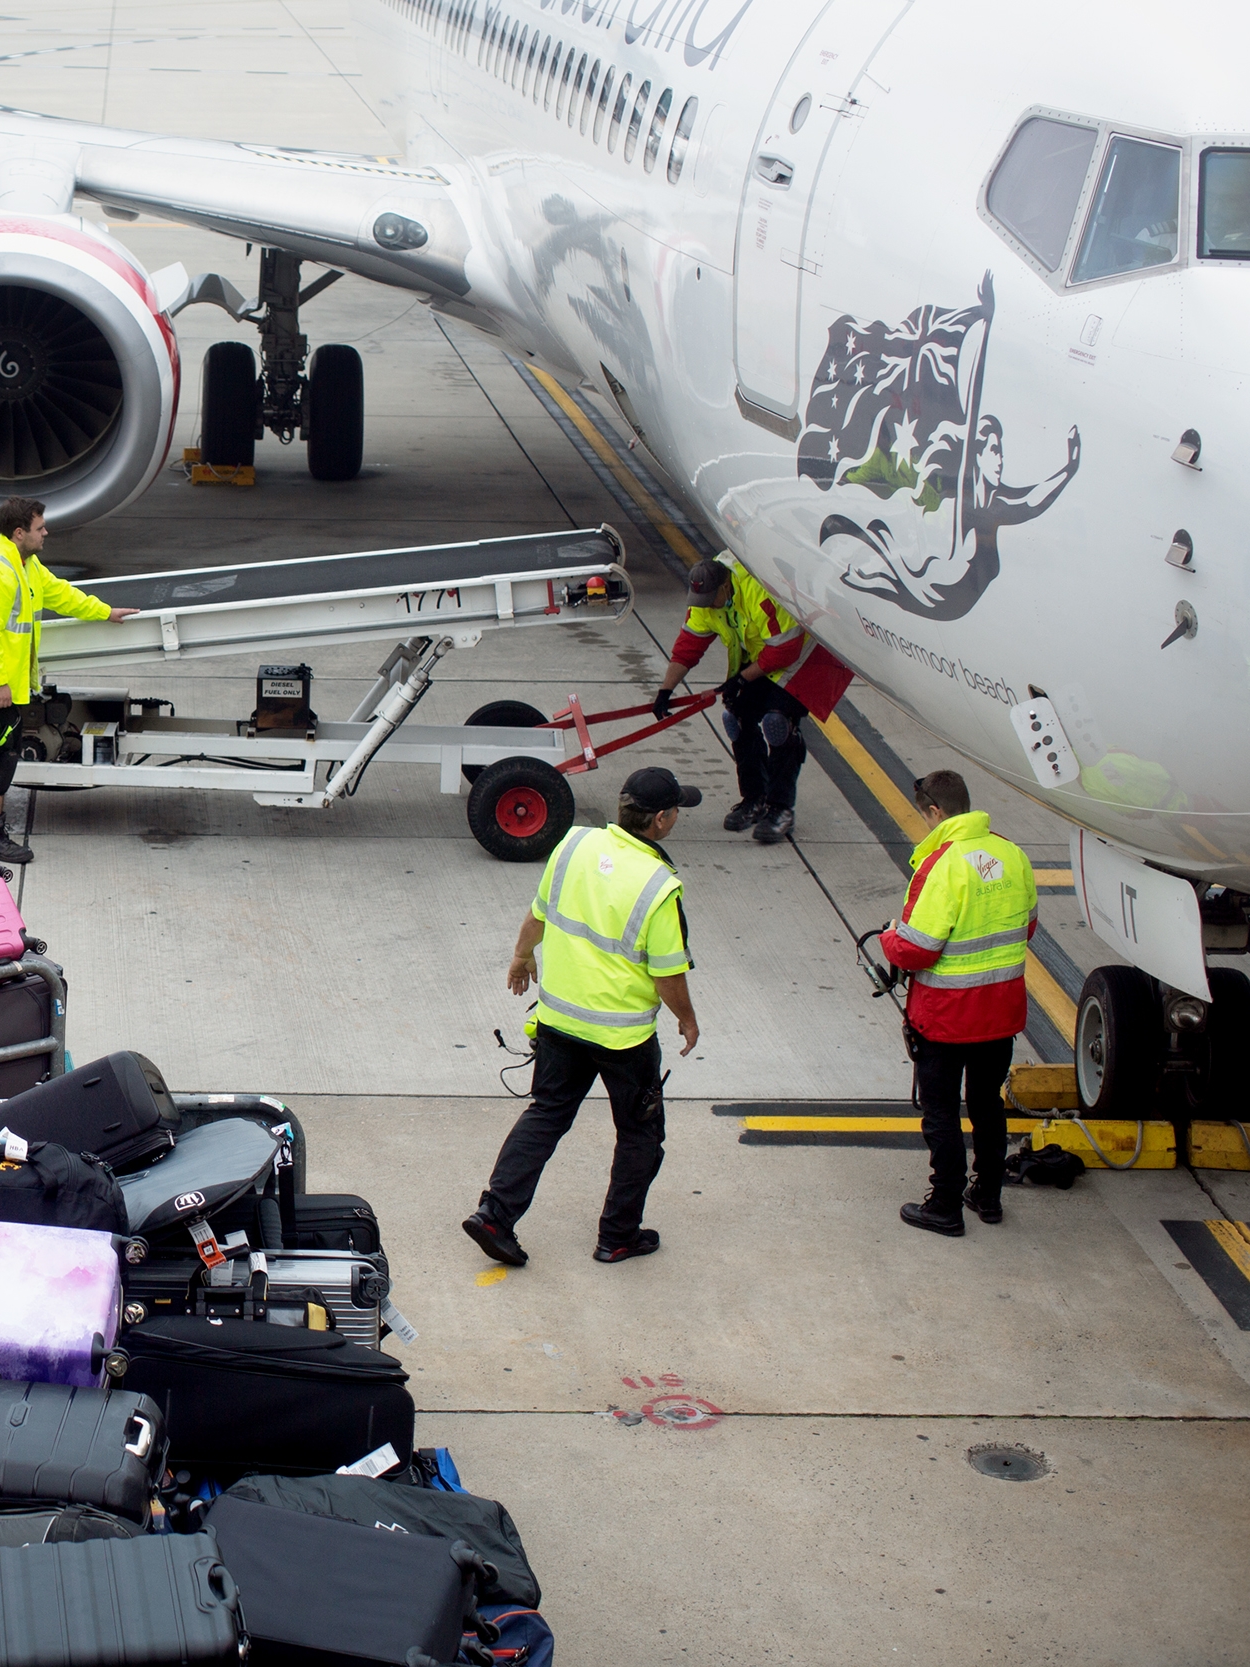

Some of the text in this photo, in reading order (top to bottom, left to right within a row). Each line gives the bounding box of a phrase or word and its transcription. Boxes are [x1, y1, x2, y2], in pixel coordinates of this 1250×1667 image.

[399, 586, 461, 613] 1771
[855, 607, 1019, 707] lammermoor beach
[1120, 882, 1138, 944] IT
